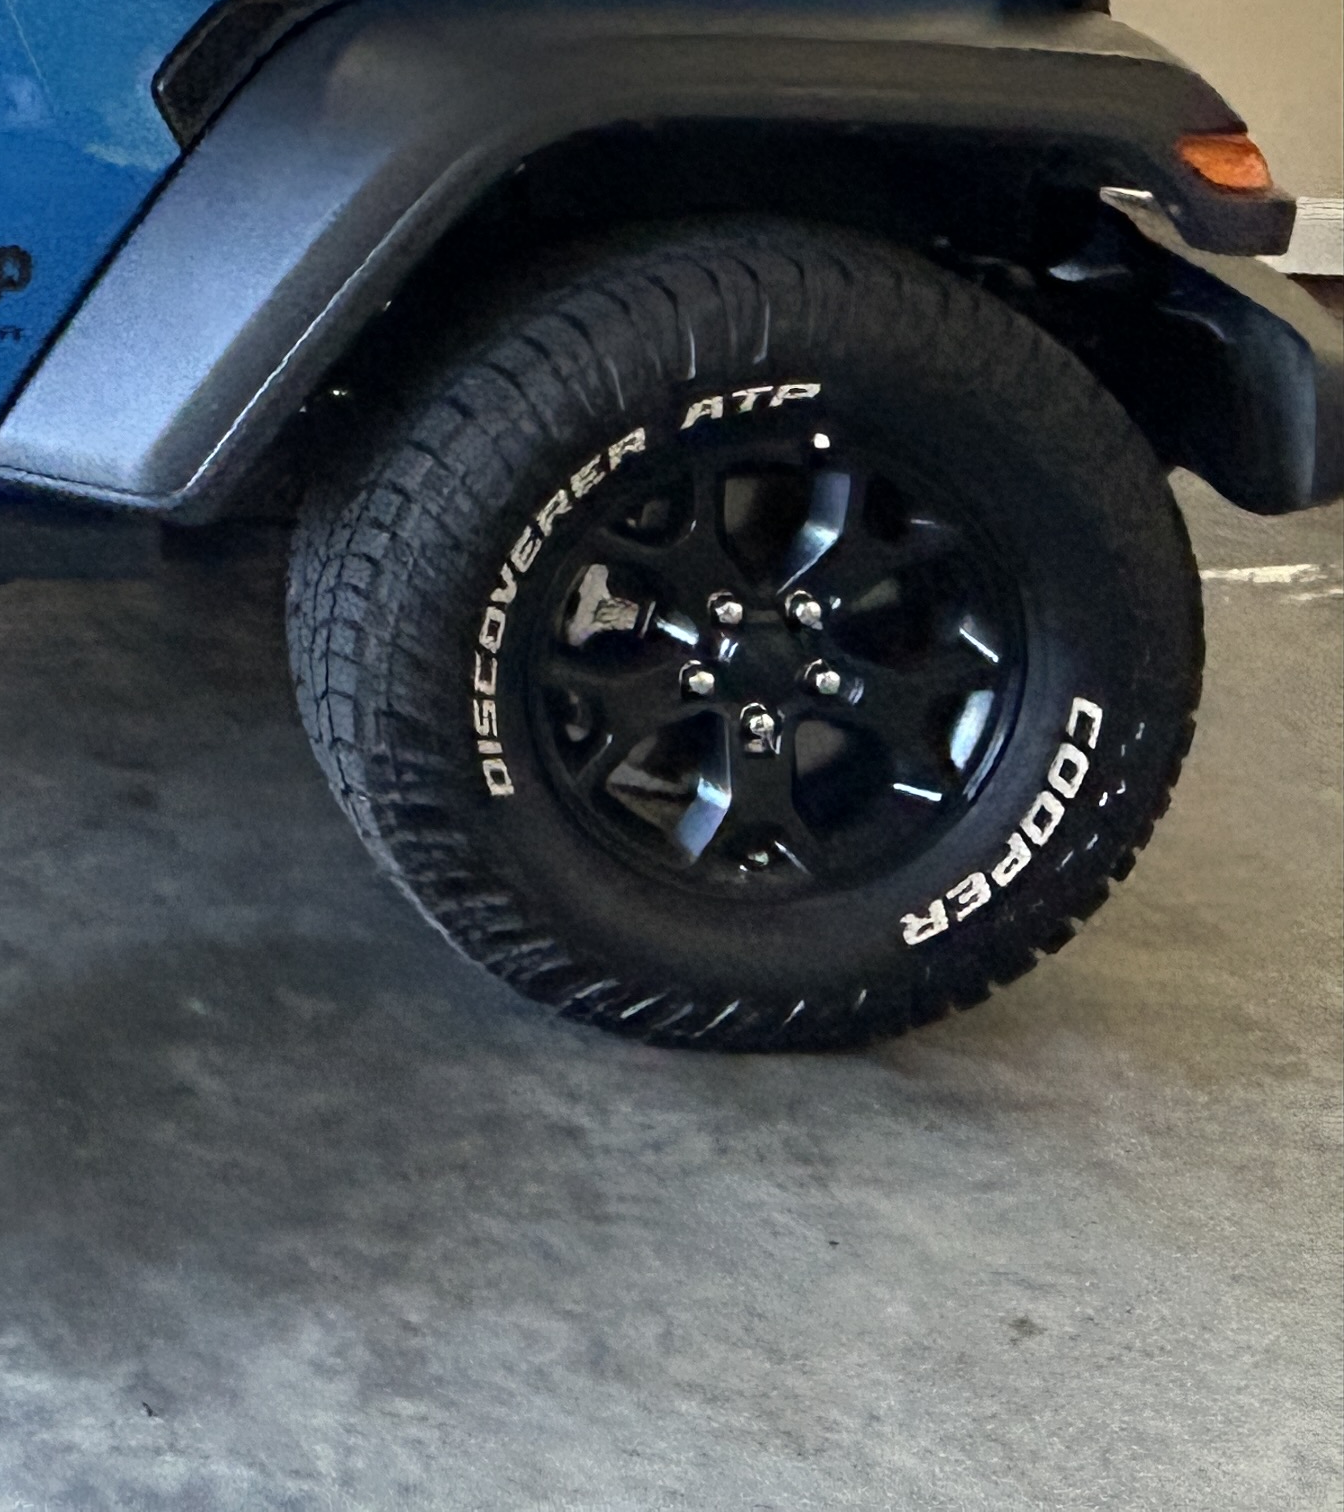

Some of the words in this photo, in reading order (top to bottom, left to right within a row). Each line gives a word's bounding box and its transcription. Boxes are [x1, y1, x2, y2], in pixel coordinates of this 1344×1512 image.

[474, 427, 646, 797] DISCOVERER
[680, 382, 821, 429] ATP
[900, 698, 1103, 945] COOPER
